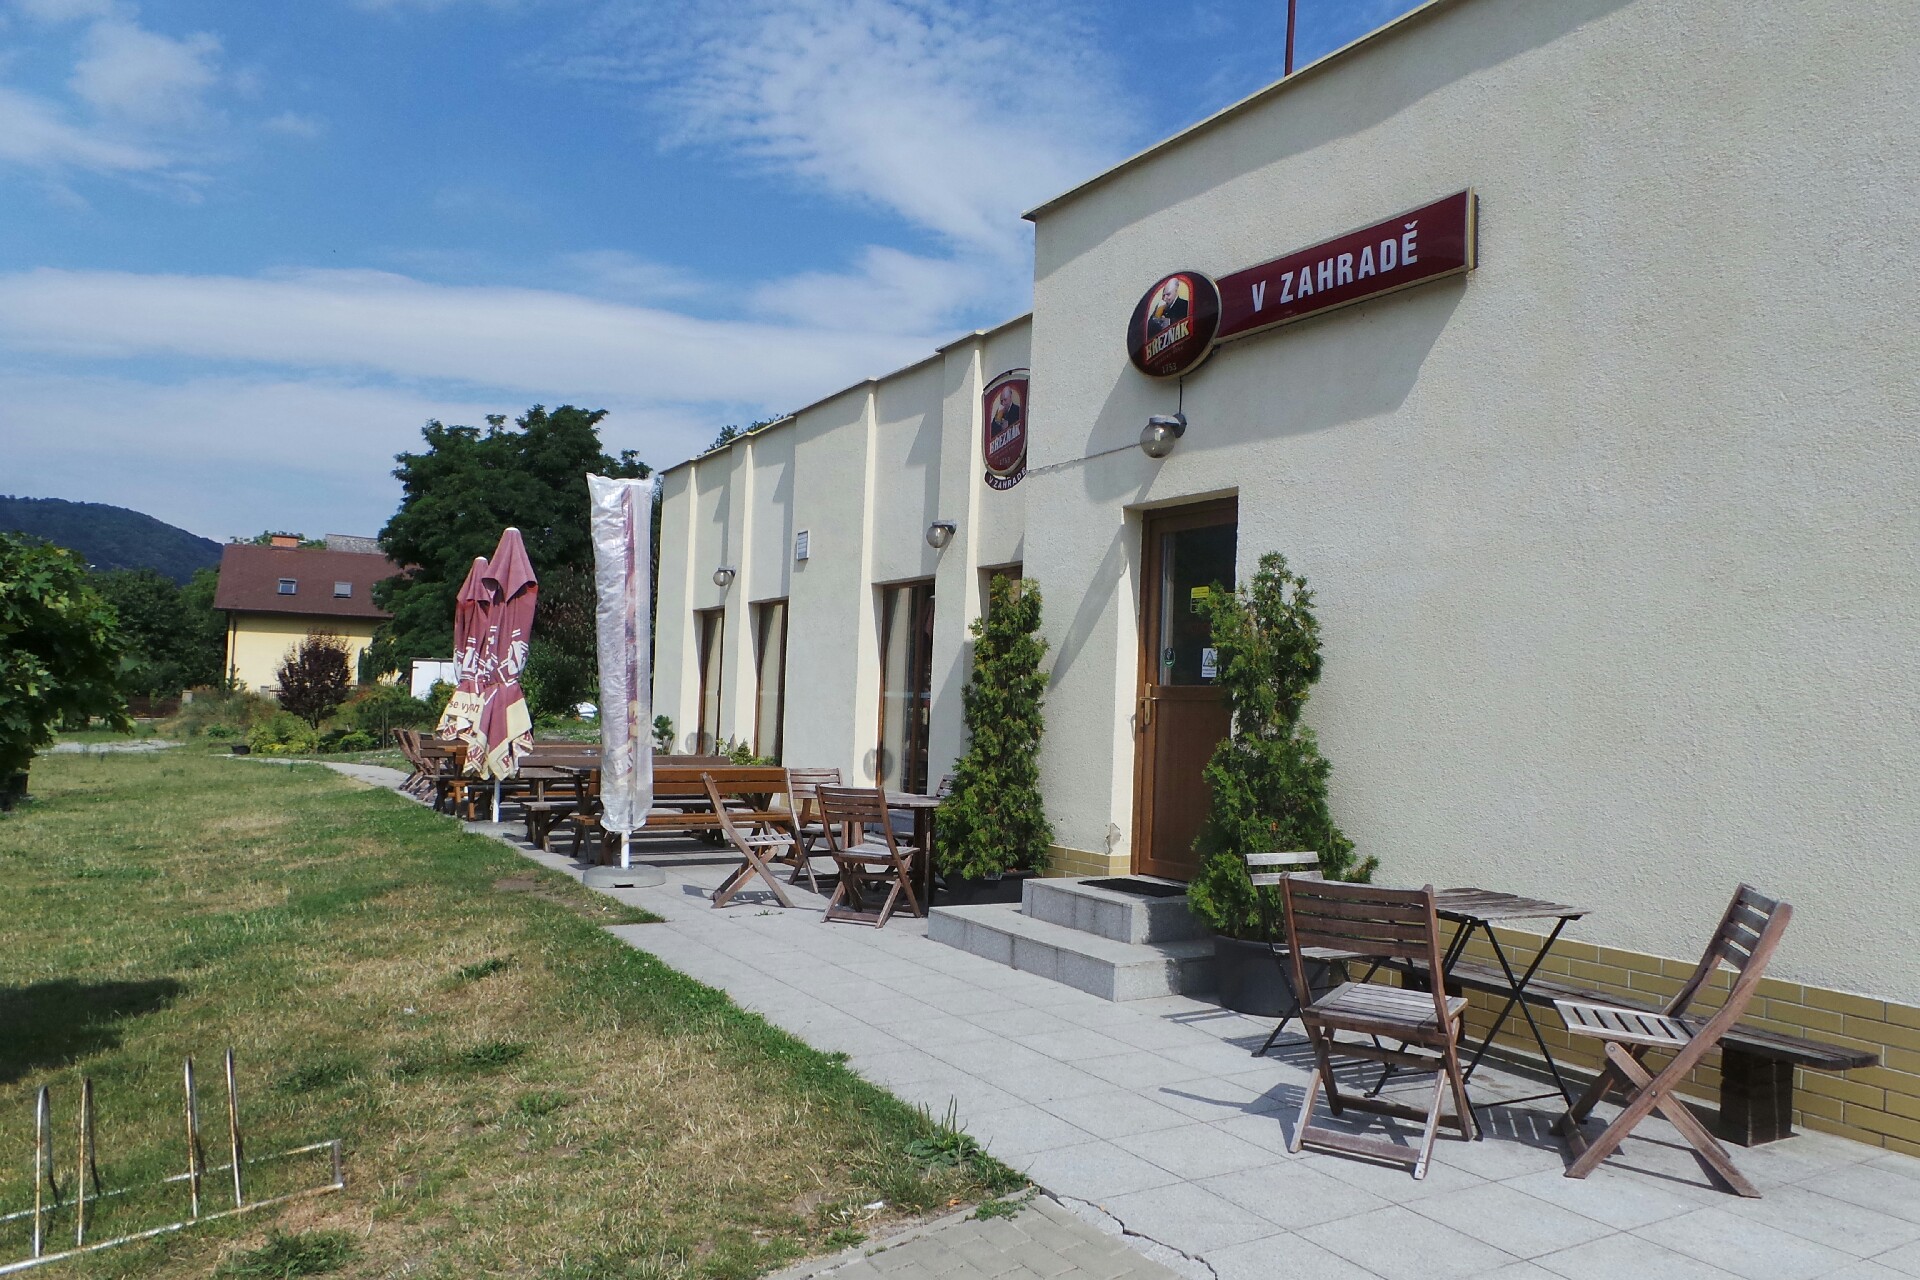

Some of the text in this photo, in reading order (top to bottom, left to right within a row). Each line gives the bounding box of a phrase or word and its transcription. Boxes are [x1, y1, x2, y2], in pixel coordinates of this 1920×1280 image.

[1251, 220, 1418, 312] V ZAHRADĚ
[1162, 362, 1177, 375] 1753
